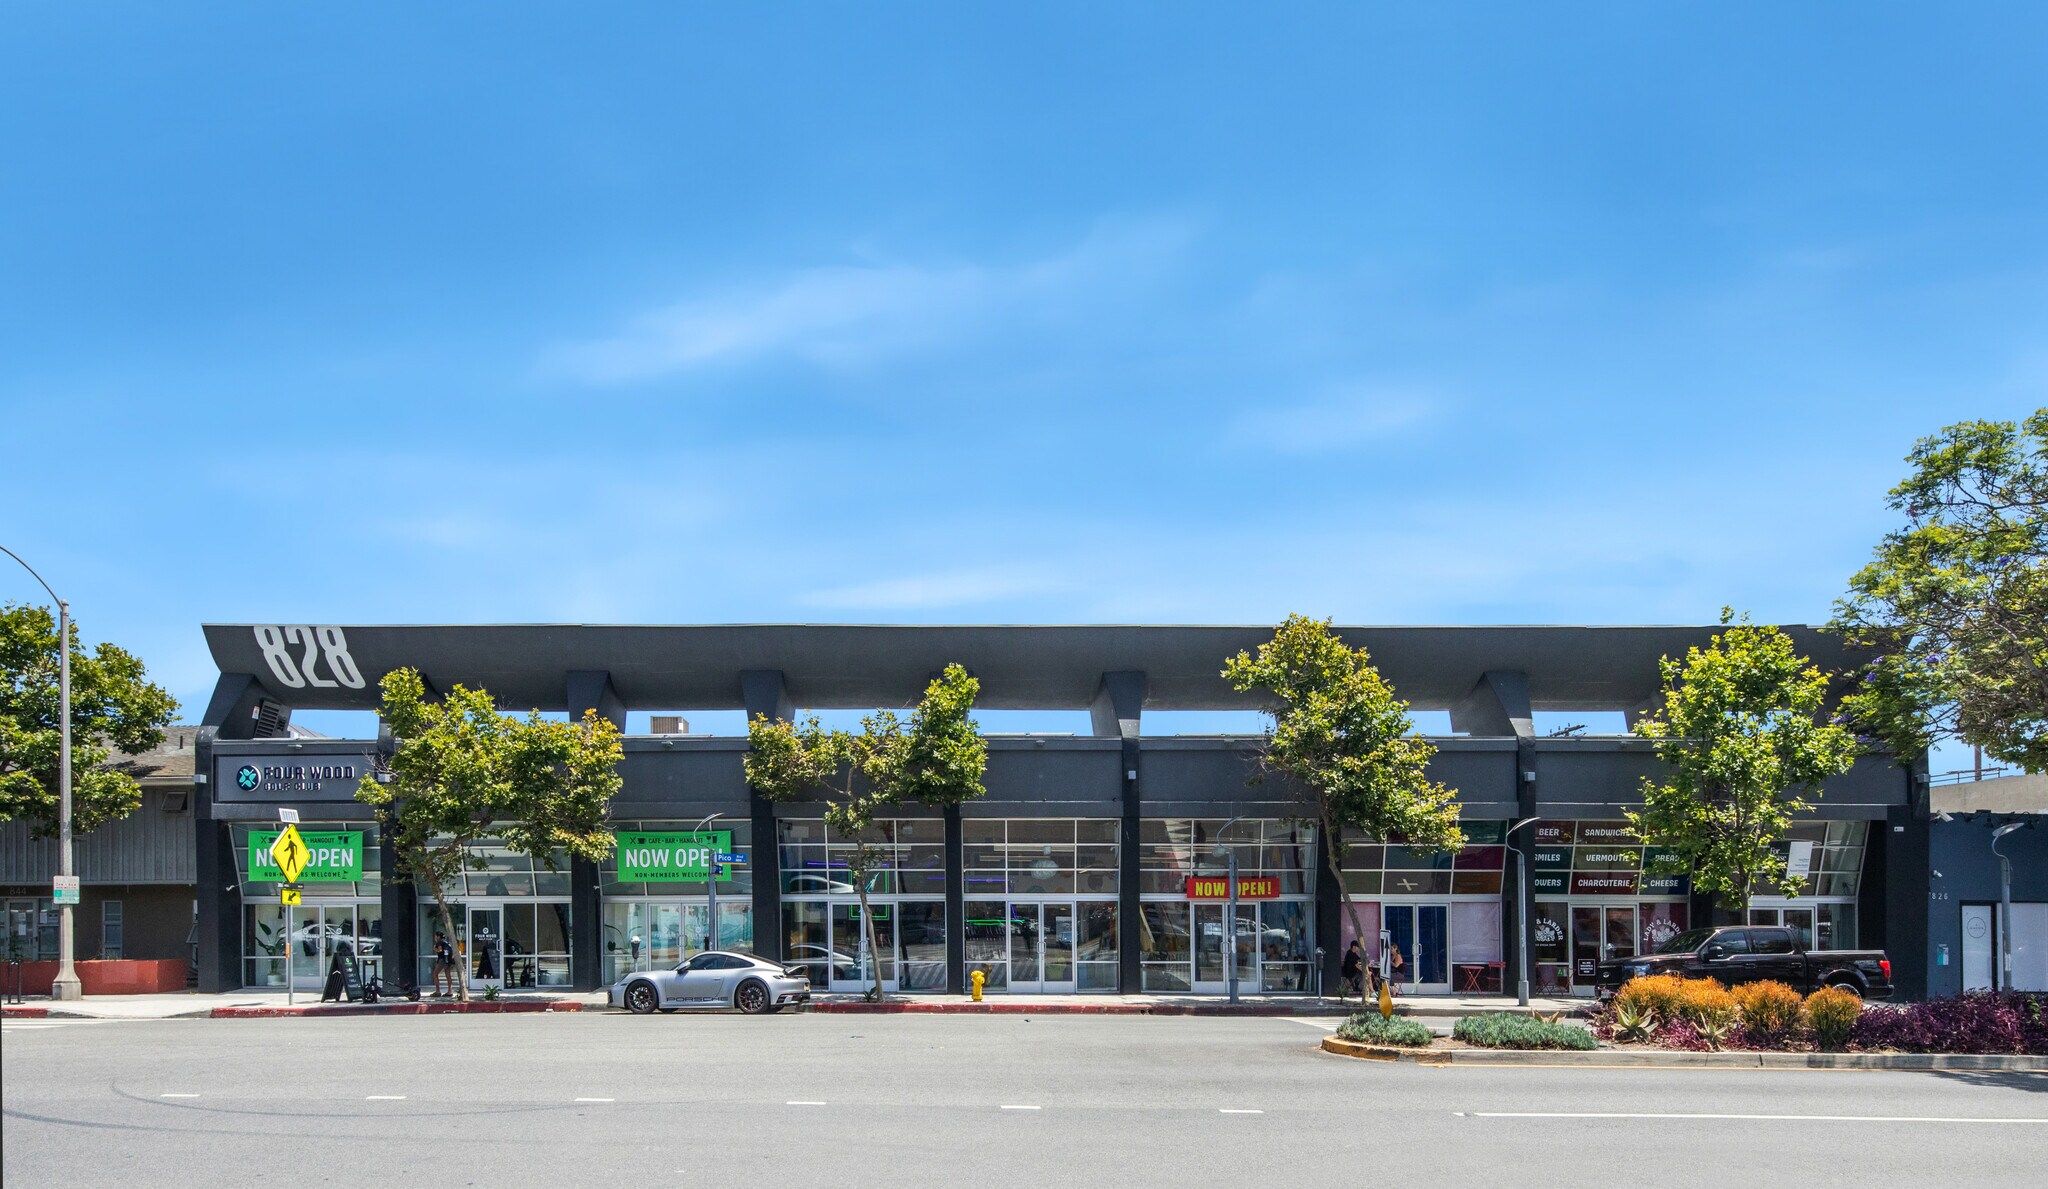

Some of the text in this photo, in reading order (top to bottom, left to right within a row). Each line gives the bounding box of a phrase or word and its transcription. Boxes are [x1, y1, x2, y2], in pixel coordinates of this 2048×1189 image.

[253, 626, 366, 689] 828
[264, 766, 355, 779] FOUR WOOD
[294, 782, 321, 791] CLUB
[1538, 828, 1560, 837] BEER
[306, 848, 354, 867] OPEN
[625, 848, 670, 868] NOW
[1195, 882, 1226, 897] NOW
[1578, 879, 1631, 887] CHARCUTERIE
[1650, 879, 1679, 887] CHEESE
[10, 887, 27, 896] 844
[1931, 892, 1949, 900] 826
[1543, 917, 1564, 941] LARDER
[1643, 921, 1655, 941] LADY
